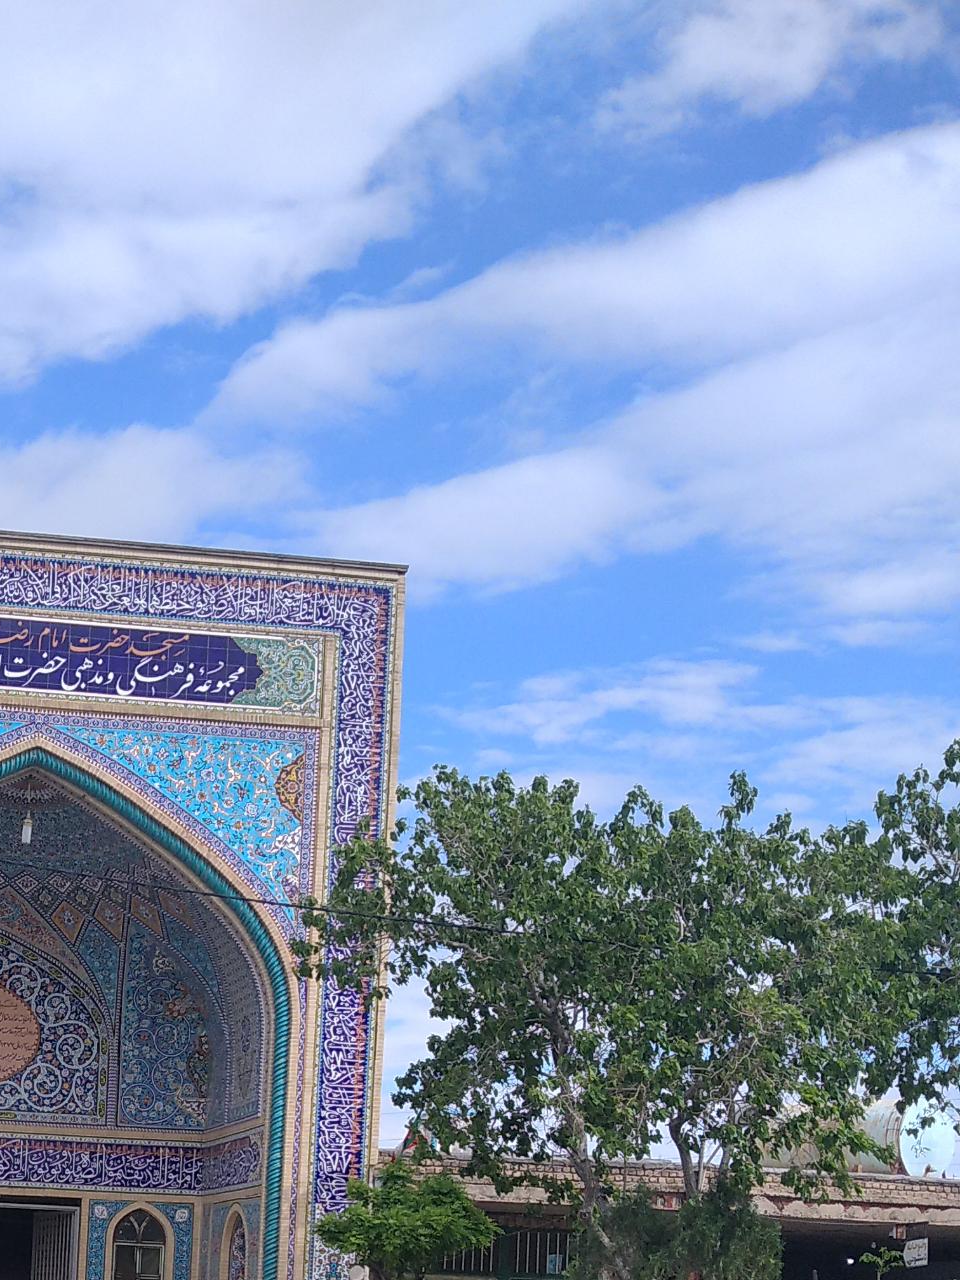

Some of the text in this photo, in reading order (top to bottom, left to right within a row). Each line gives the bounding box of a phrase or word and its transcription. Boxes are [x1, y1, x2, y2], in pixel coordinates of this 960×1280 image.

[39, 627, 66, 653] امام
[70, 629, 129, 655] حضرت
[126, 633, 190, 660] مسجد
[3, 653, 67, 687] حضرت
[116, 657, 194, 698] فرهنگی
